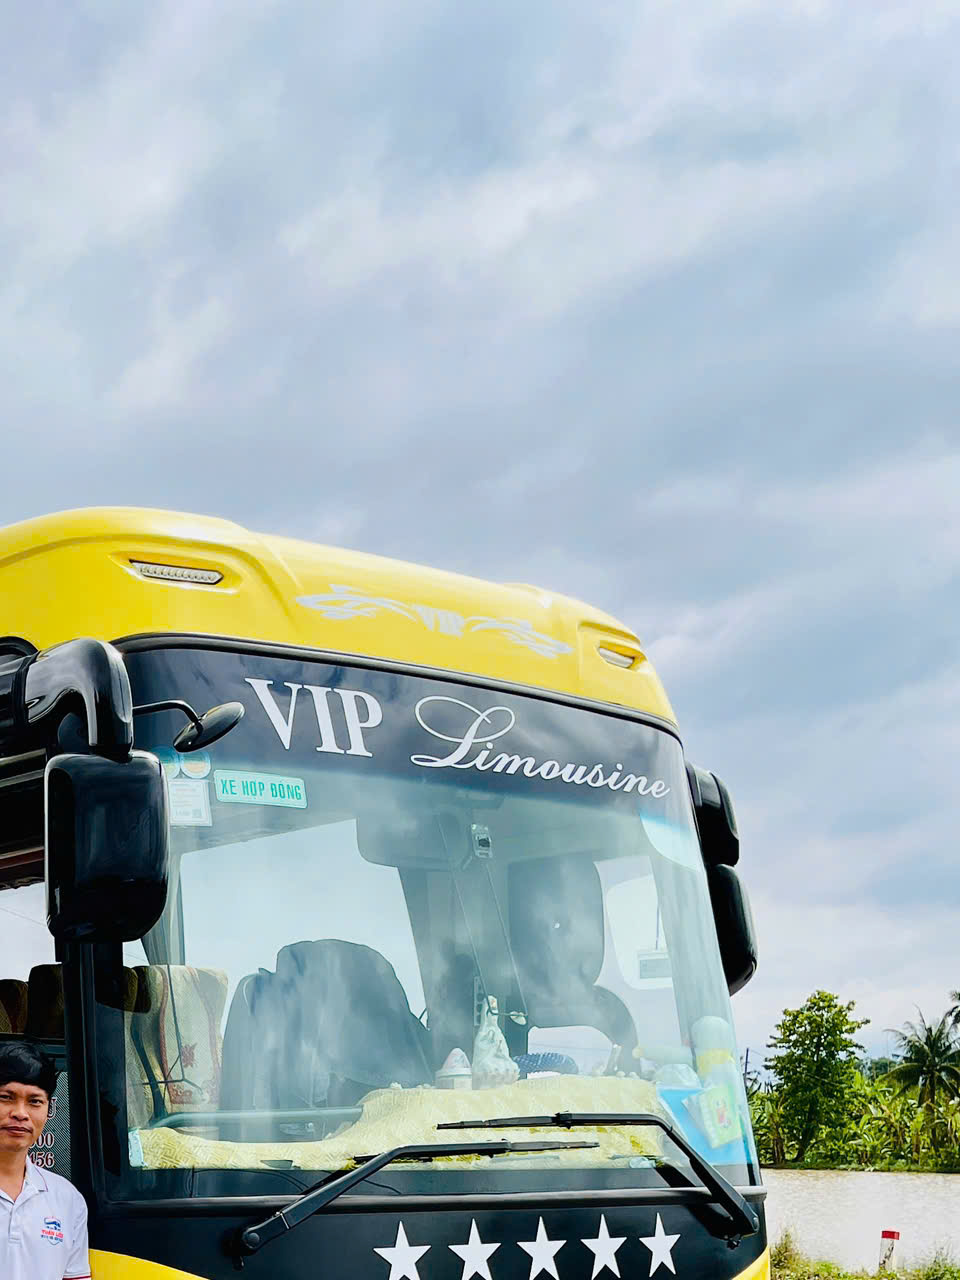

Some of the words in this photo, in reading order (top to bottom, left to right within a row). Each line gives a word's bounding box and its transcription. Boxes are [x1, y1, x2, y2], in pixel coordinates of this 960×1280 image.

[244, 677, 384, 758] VIP
[410, 695, 671, 800] Limousine
[220, 779, 238, 795] XE
